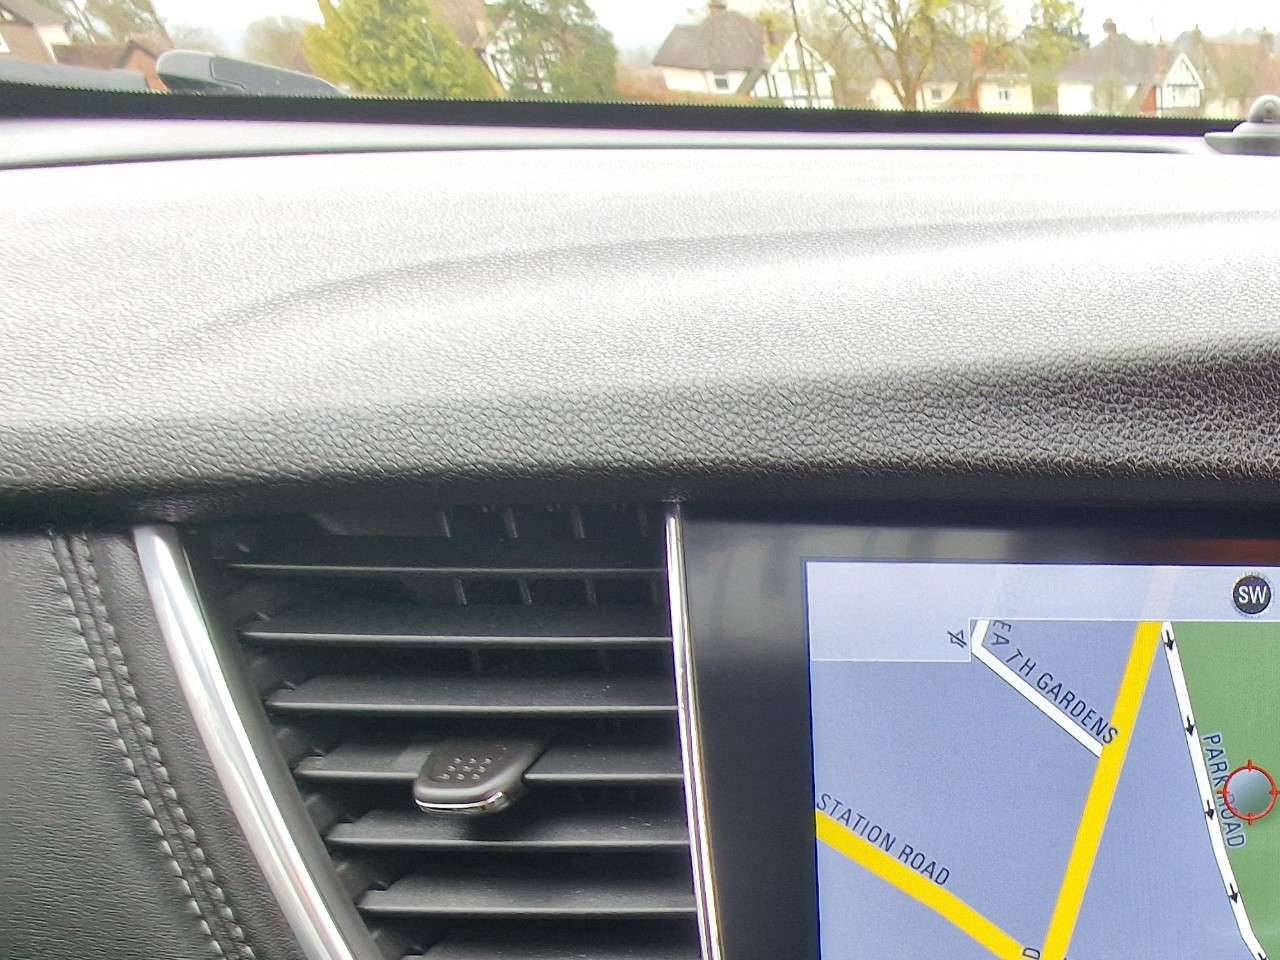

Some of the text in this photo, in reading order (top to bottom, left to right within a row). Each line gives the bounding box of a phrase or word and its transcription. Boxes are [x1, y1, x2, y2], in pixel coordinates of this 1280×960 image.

[1238, 585, 1267, 604] SW
[1036, 672, 1118, 745] GARDENS
[1203, 733, 1230, 788] PARK
[816, 792, 951, 886] STATION ROAD
